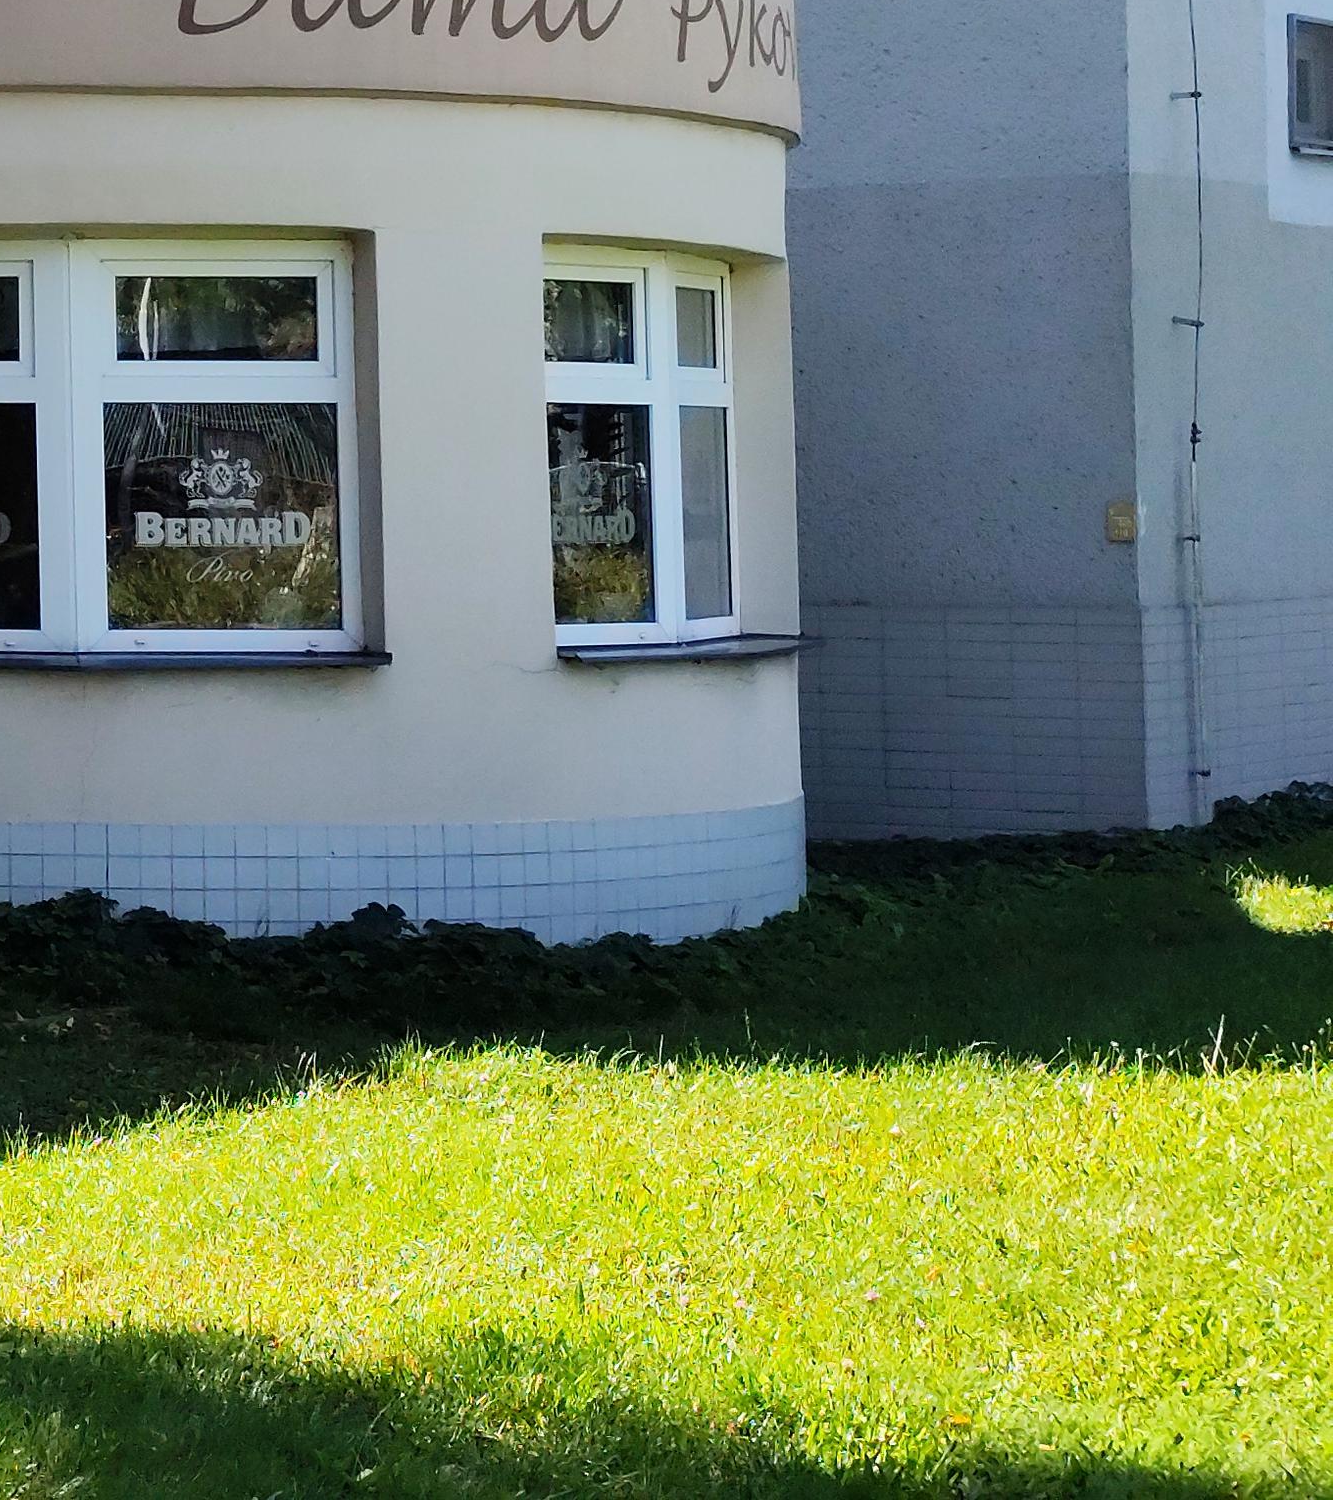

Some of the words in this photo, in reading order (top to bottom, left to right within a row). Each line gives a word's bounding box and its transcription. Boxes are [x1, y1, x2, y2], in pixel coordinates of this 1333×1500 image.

[134, 511, 312, 547] BERNARD
[552, 508, 637, 544] ERNARD
[186, 550, 255, 583] Pivo
